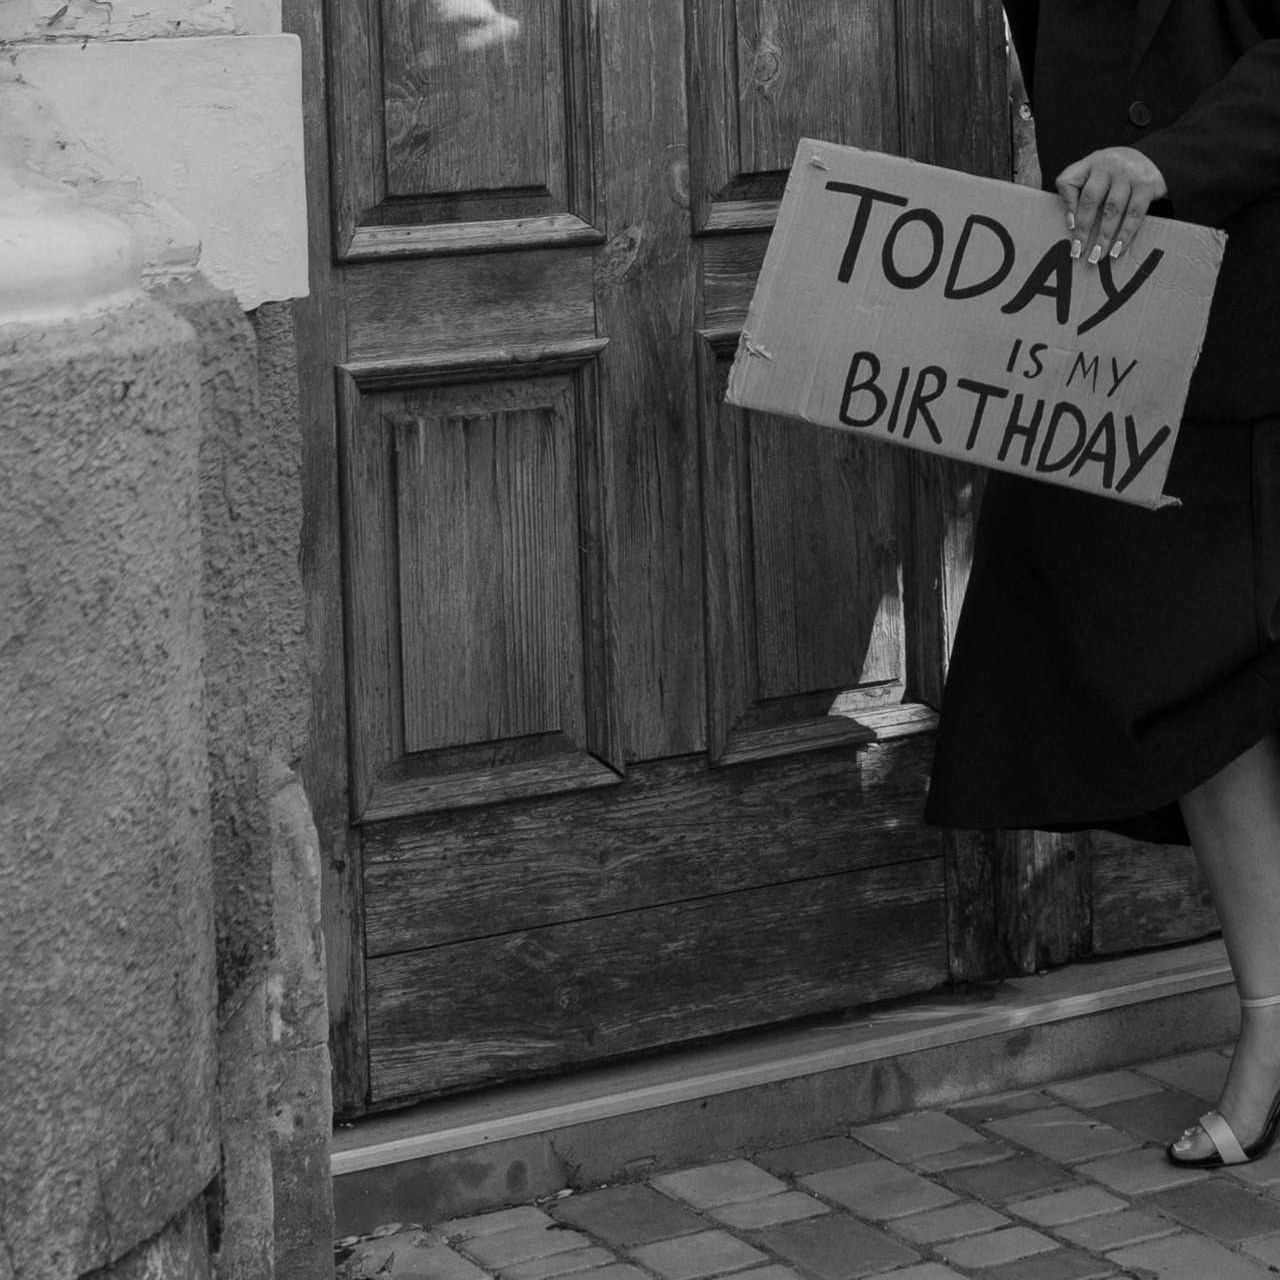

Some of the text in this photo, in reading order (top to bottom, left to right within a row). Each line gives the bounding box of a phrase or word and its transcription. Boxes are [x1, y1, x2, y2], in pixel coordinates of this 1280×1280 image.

[825, 181, 1165, 336] TODAY
[838, 351, 1172, 493] BIRTHDAY
[1006, 339, 1138, 397] IS MY
